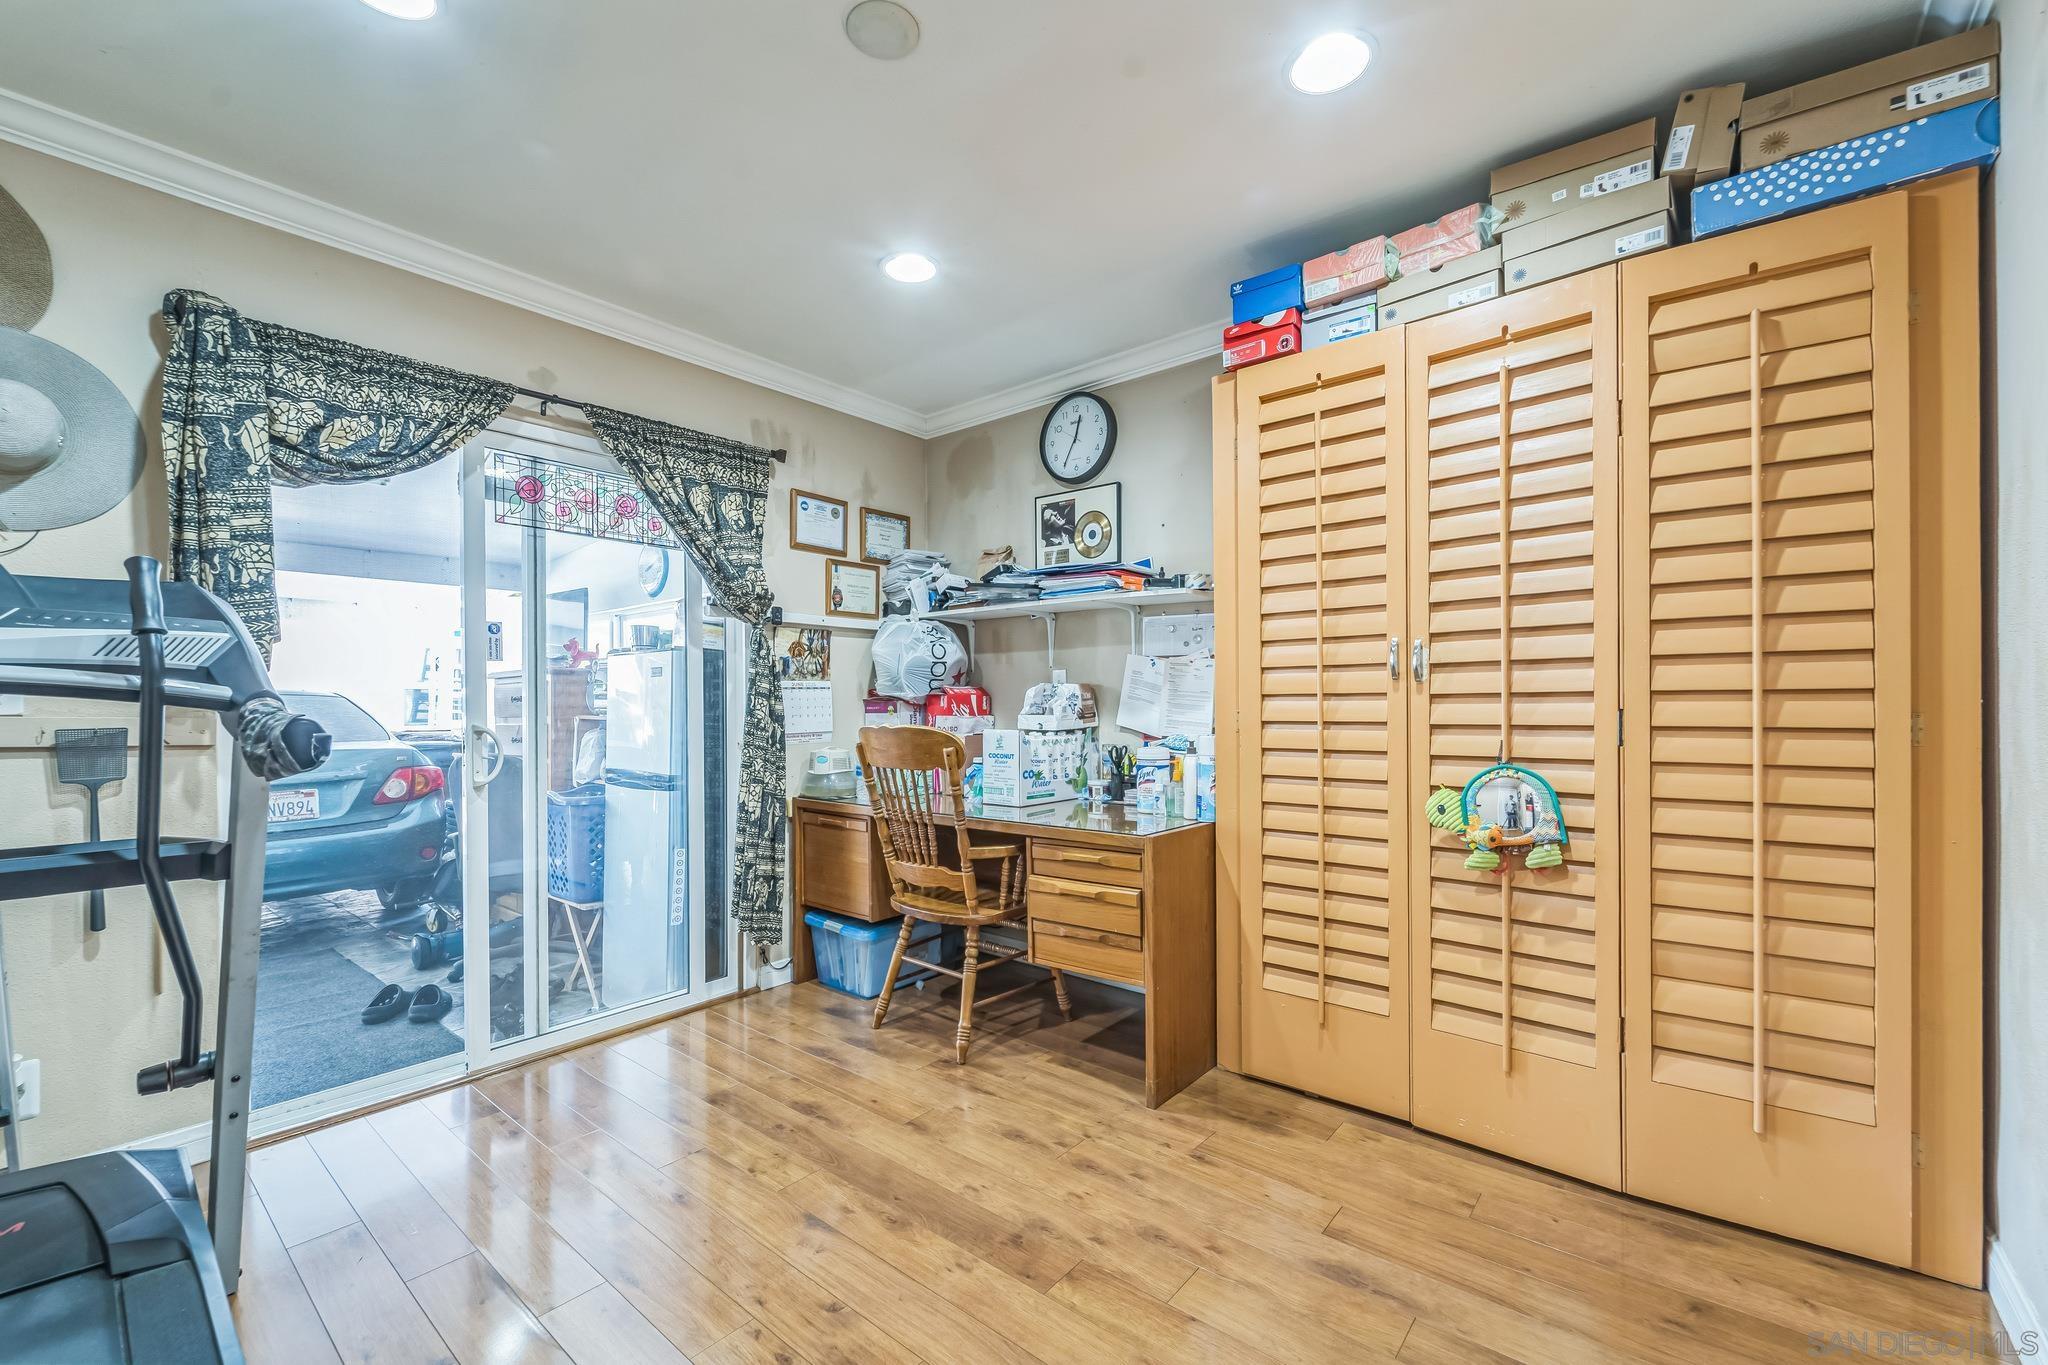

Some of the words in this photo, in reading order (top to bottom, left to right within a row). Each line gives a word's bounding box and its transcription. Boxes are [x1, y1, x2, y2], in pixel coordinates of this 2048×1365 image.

[1072, 404, 1080, 413] 12
[1086, 405, 1089, 413] 1
[1062, 411, 1068, 420] 11
[1094, 414, 1100, 423] 2
[1054, 425, 1063, 434] 10
[1098, 427, 1104, 436] 3
[1095, 443, 1100, 451] 4
[1054, 454, 1059, 462] 8
[1086, 456, 1091, 464] 5
[1074, 464, 1079, 472] 6
[922, 625, 948, 694] macy's
[988, 752, 1015, 760] COCONUT
[1138, 767, 1156, 780] Lysol
[1031, 780, 1052, 789] Water
